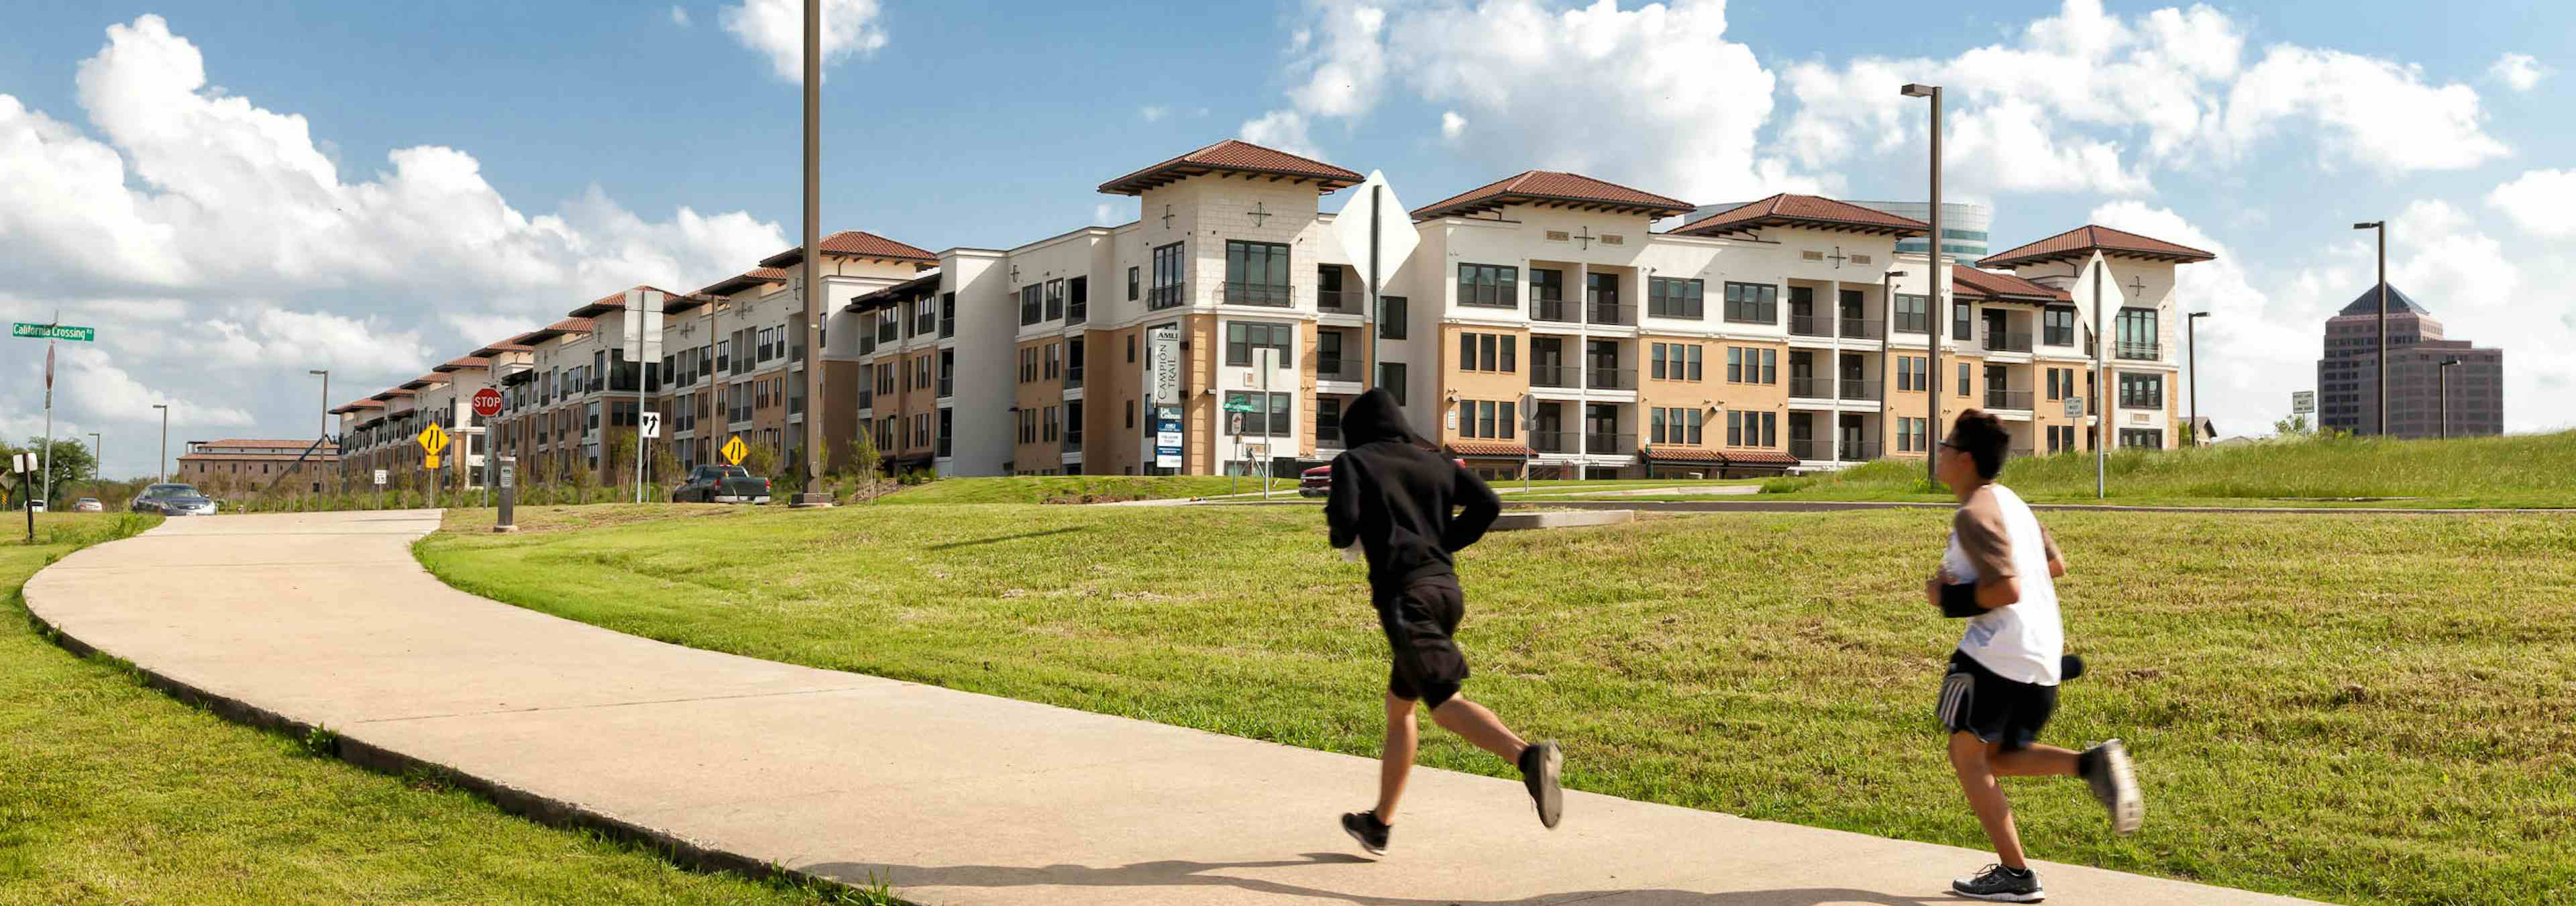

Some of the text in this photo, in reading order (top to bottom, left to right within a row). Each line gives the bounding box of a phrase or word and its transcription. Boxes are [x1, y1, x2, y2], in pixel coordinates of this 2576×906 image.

[13, 323, 51, 336] California
[52, 326, 86, 342] Crossing
[1168, 356, 1177, 388] TRAIL
[474, 397, 500, 407] STOP
